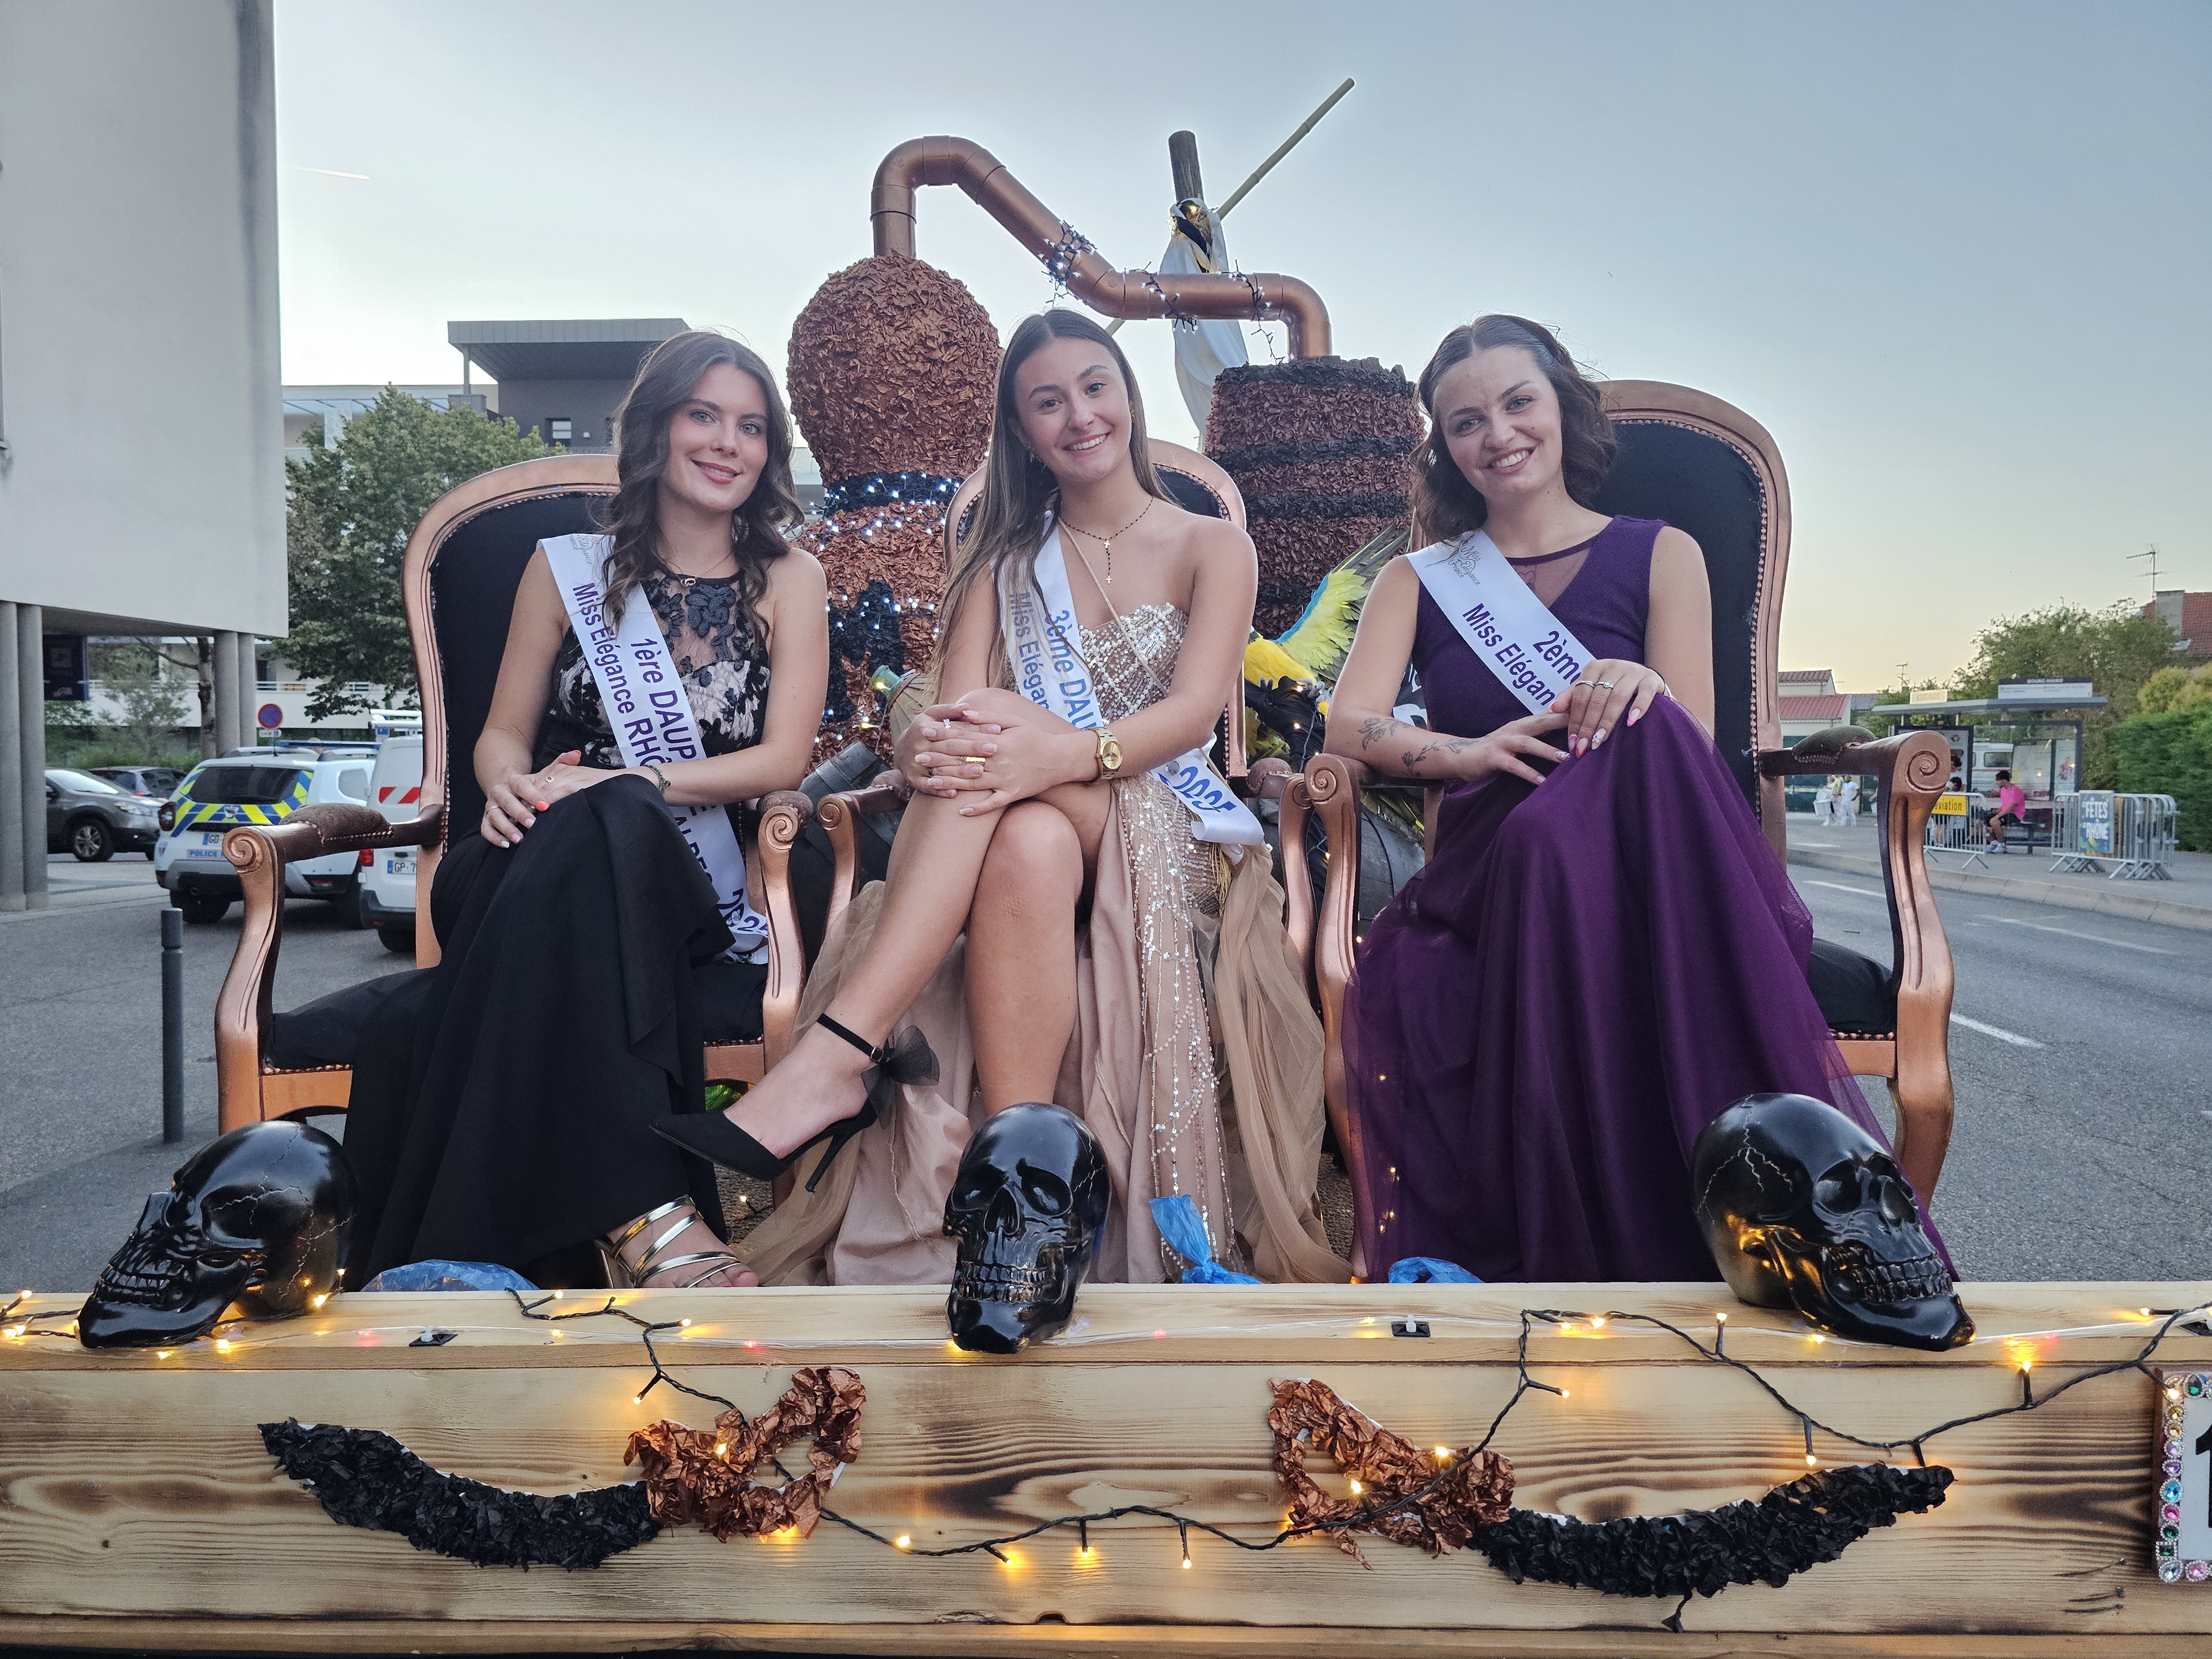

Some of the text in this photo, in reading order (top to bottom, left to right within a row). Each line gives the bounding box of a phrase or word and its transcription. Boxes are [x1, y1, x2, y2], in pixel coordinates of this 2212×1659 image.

[1448, 559, 1464, 578] France
[1461, 546, 1481, 561] Miss
[1009, 592, 1034, 638] Miss
[1463, 603, 1503, 647] Miss
[573, 583, 601, 625] Miss
[590, 626, 635, 714] Elégance
[1045, 610, 1074, 673] 3ème
[1532, 630, 1581, 684] 2èm
[631, 638, 700, 760] 1ère DAUP
[2085, 796, 2107, 818] FÊTES
[2086, 818, 2108, 840] RHÔNE
